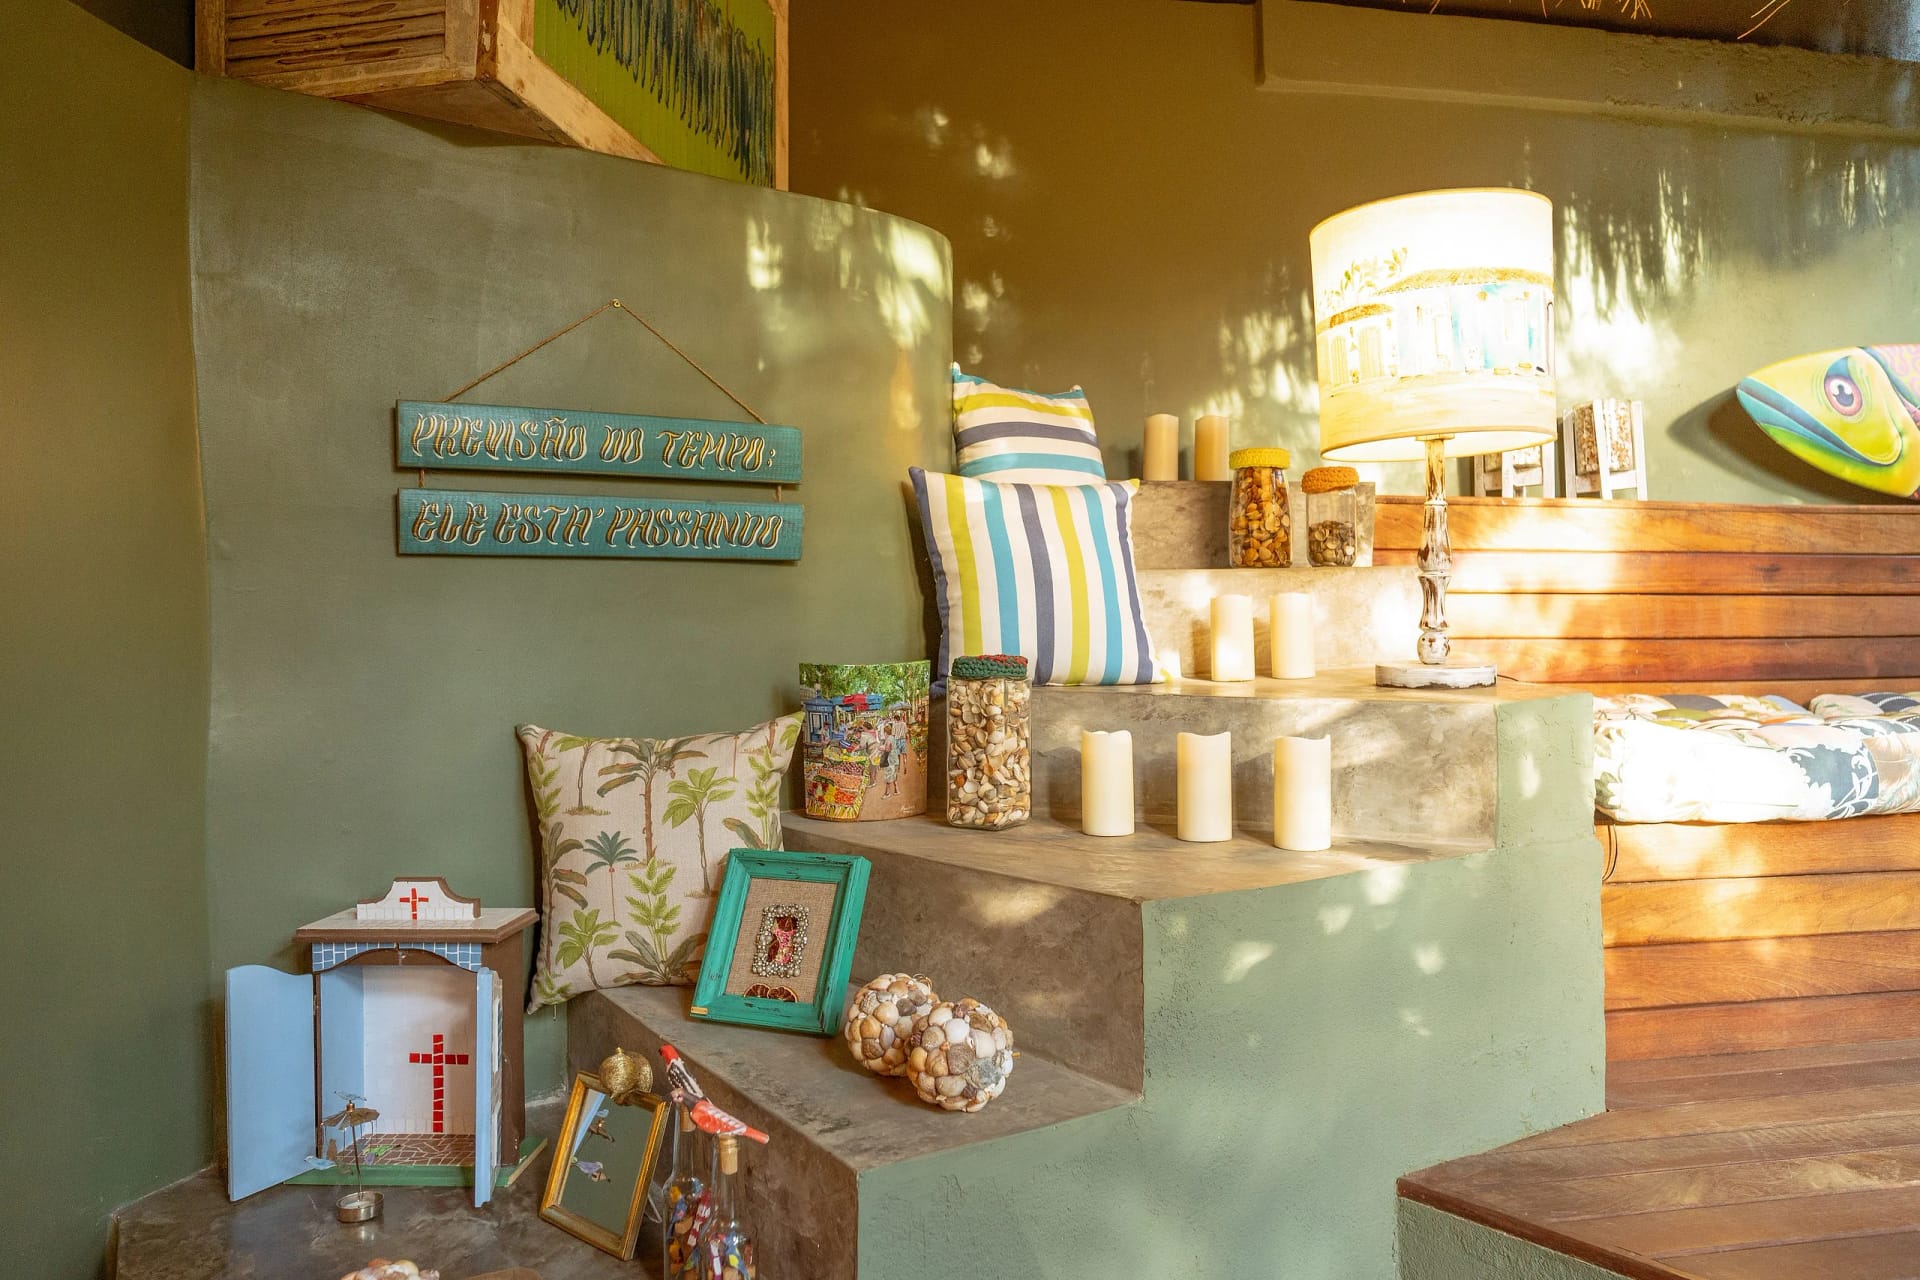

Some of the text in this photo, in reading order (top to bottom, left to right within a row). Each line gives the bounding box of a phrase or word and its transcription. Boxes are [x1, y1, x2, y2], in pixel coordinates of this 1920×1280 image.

[411, 412, 777, 473] PREVISÃO DO TEMPO:
[411, 499, 489, 547] ELE
[605, 505, 784, 550] PASSANDO
